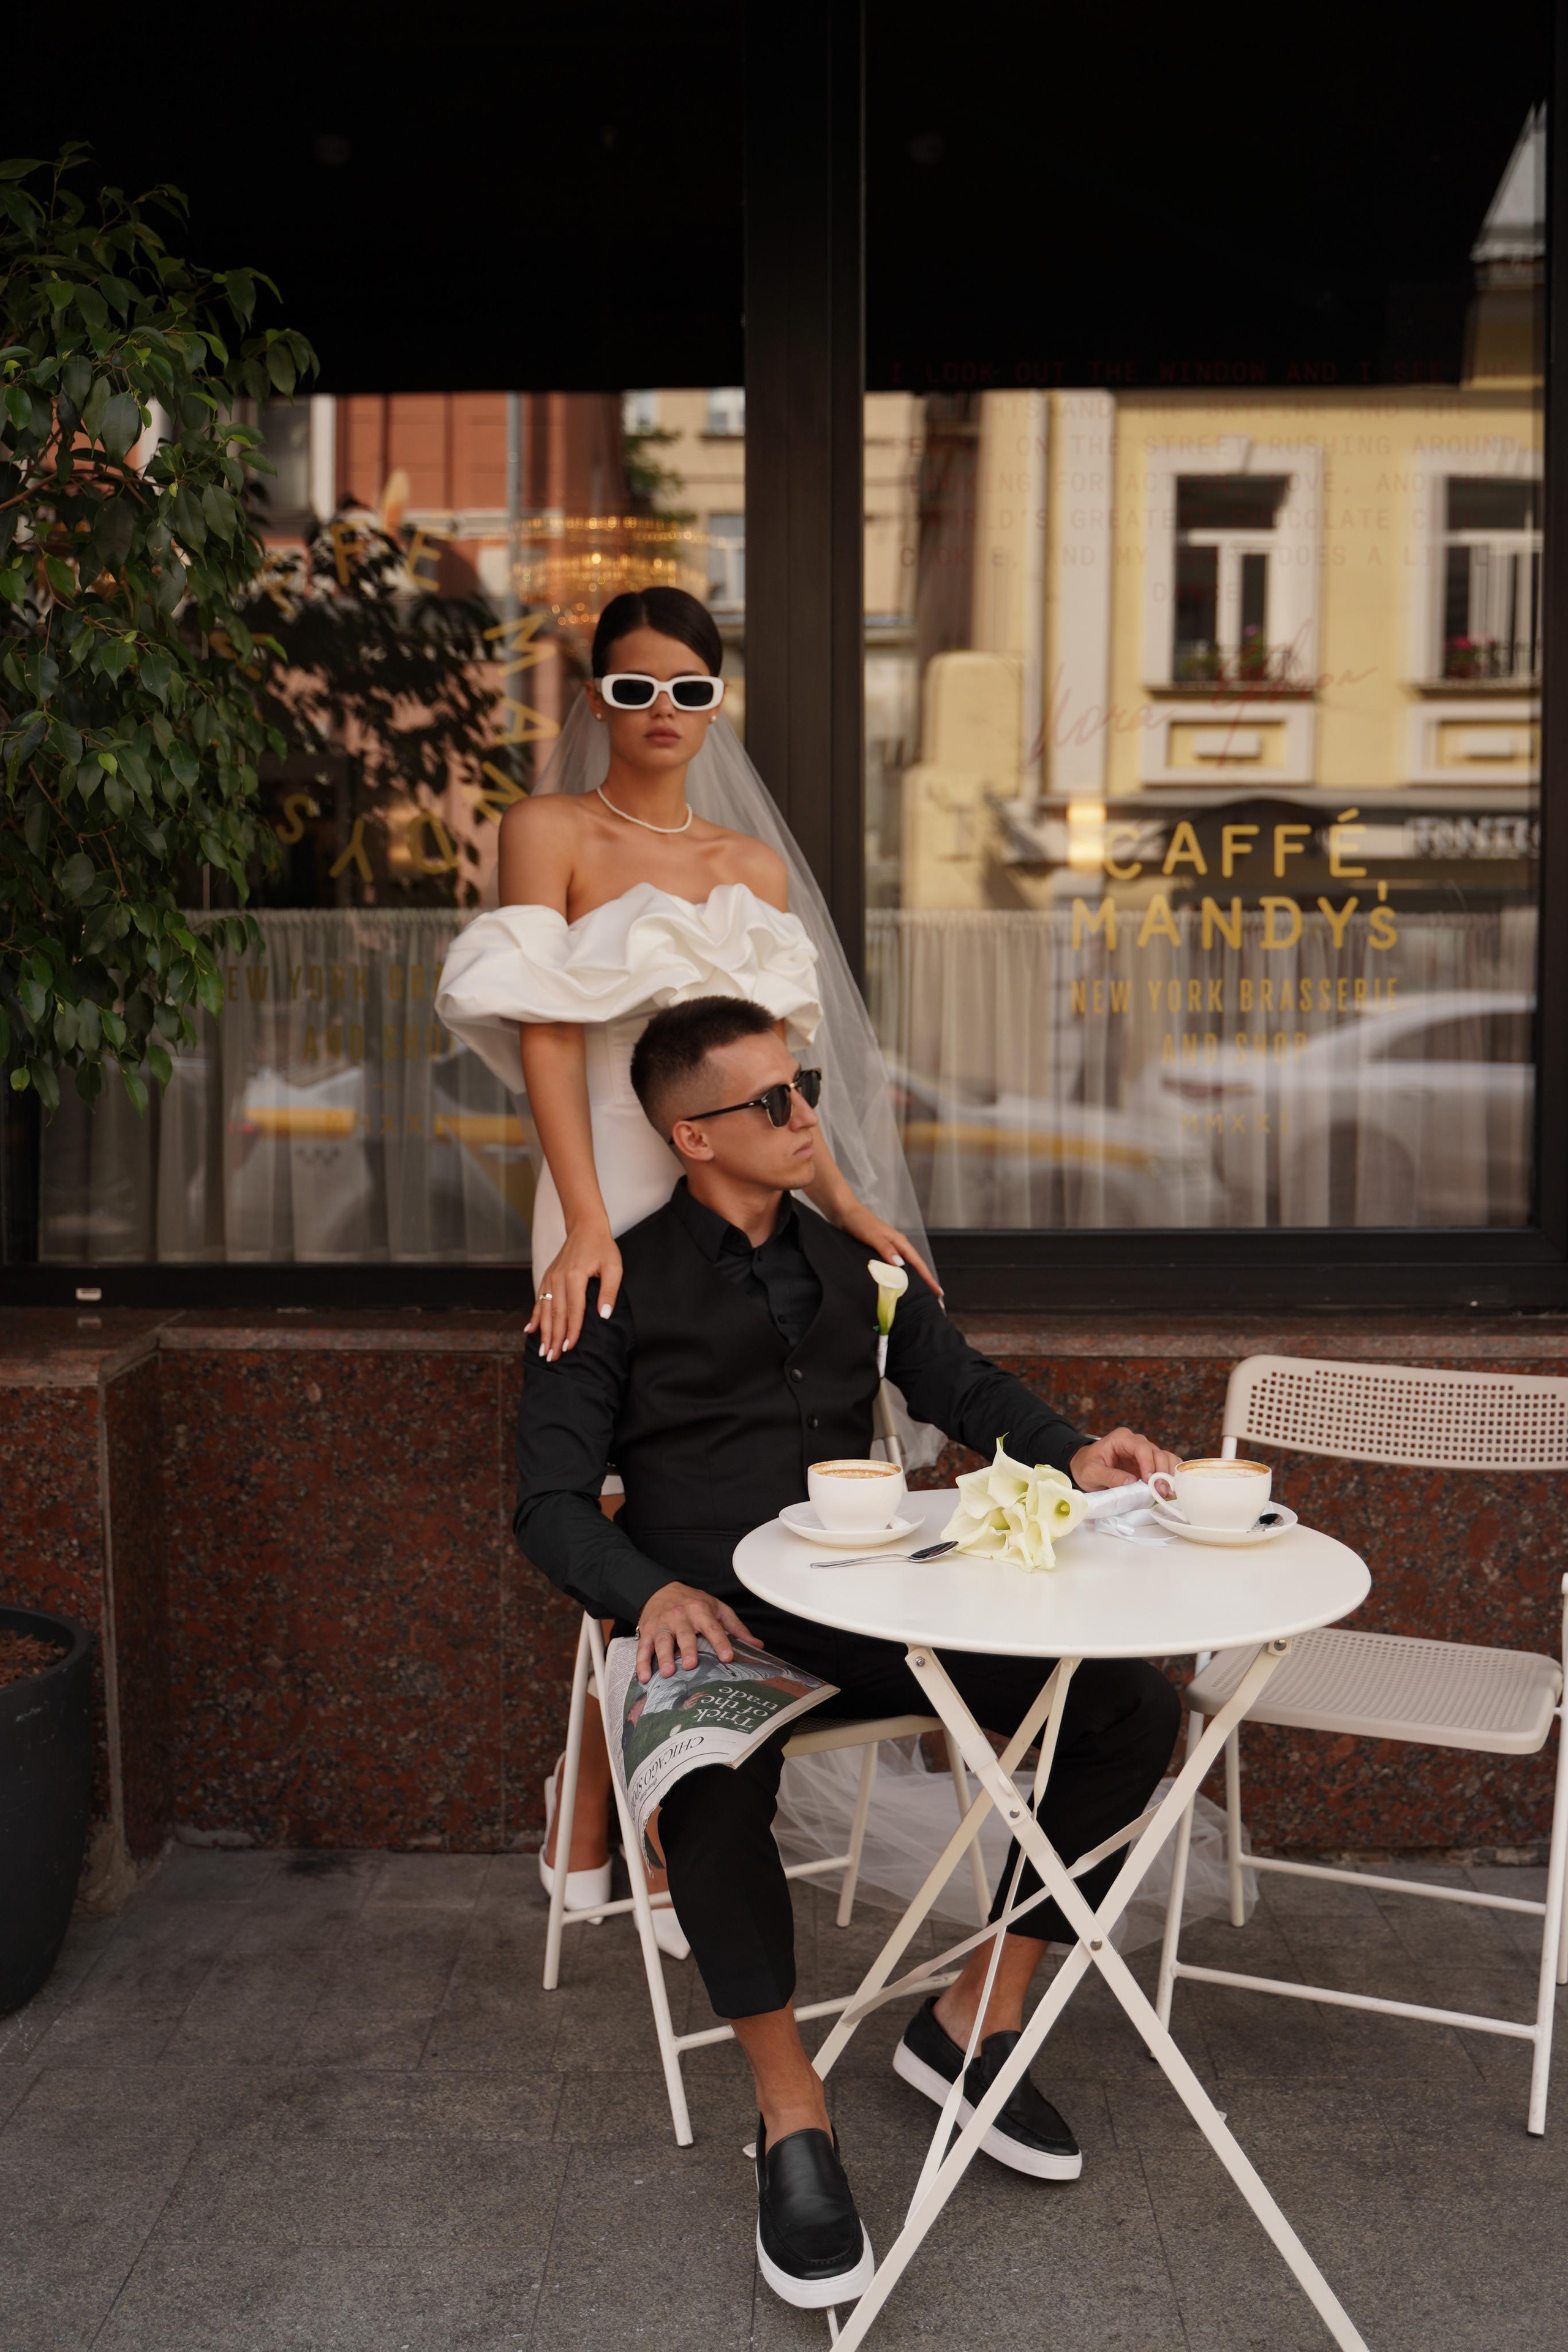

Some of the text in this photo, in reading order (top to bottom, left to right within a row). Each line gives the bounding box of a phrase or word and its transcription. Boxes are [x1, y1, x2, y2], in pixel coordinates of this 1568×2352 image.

[890, 360, 901, 384] I
[924, 360, 993, 384] LOOK
[1014, 360, 1065, 384] OUT
[1087, 360, 1137, 384] THE
[1159, 360, 1264, 384] WINDOW
[1285, 360, 1336, 384] AND
[1359, 360, 1370, 384] I
[1393, 360, 1444, 384] SEE
[1061, 396, 1112, 419] AND
[1350, 396, 1401, 419] AND
[1069, 434, 1120, 456] THE
[1142, 434, 1247, 456] STREET
[1268, 434, 1391, 456] RUSHING
[1412, 434, 1517, 456] AROUND
[1052, 472, 1102, 494] FOR
[1376, 472, 1427, 494] AND
[1071, 508, 1212, 530] GREATEST
[1413, 508, 1482, 530] CHIP
[1368, 545, 1383, 567] A
[1104, 807, 1368, 880] CAFFÉ
[228, 965, 268, 1002] EW
[287, 965, 368, 1001] YORK
[1071, 977, 1399, 1014] NEW YORK BRASSERIE
[302, 1023, 365, 1061] AND
[1162, 1033, 1308, 1066] AND SHOP
[1180, 1113, 1292, 1135] MMXXI
[700, 1695, 769, 1717] of the
[718, 1686, 779, 1711] trade
[692, 1708, 755, 1728] Trick
[644, 1736, 704, 1786] CHICAGO
